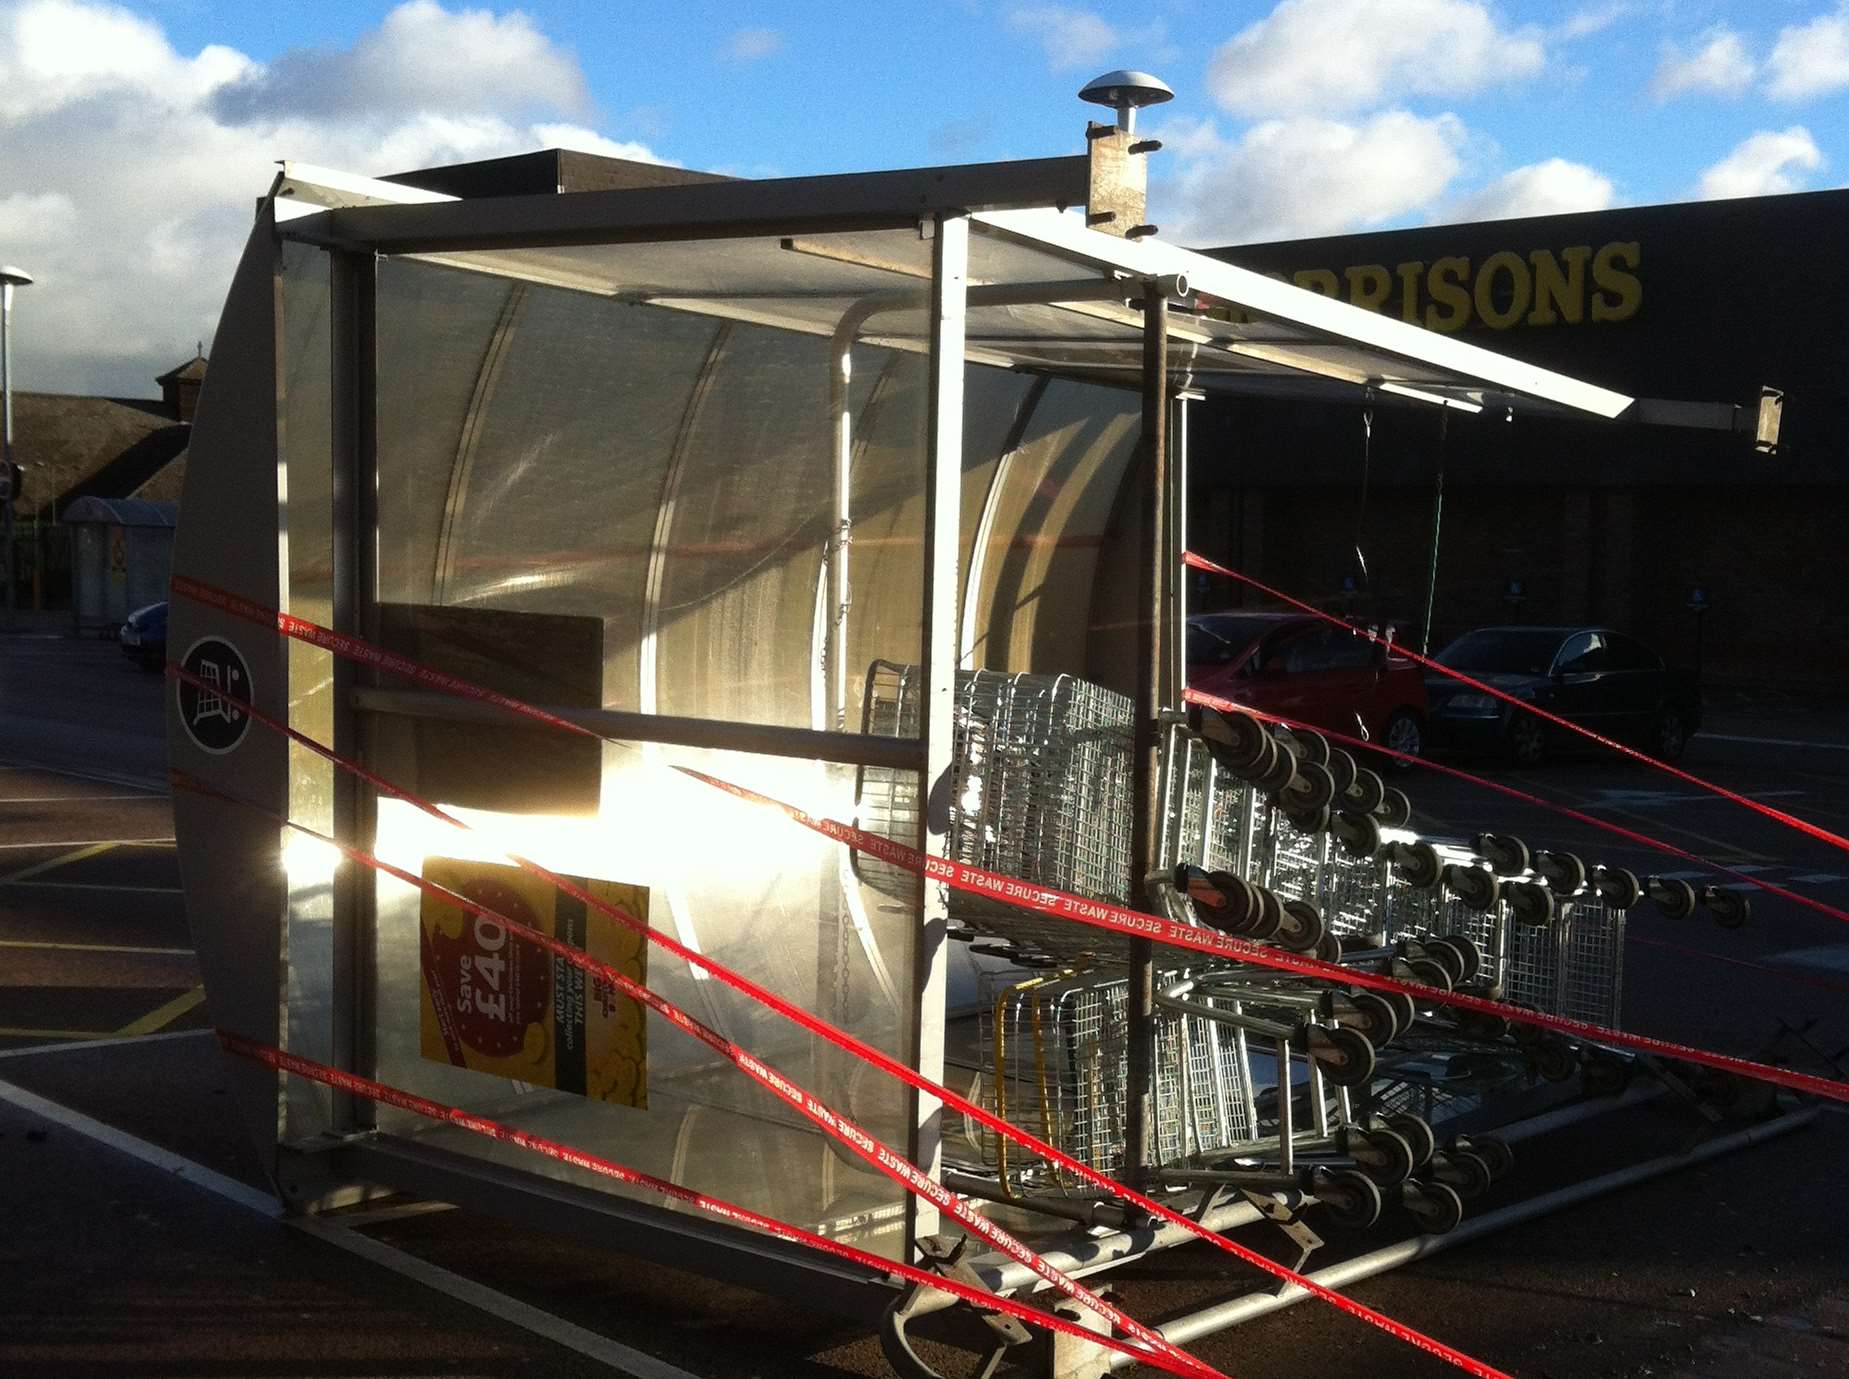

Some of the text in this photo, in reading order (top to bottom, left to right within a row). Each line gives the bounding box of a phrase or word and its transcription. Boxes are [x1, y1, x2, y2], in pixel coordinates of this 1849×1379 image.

[457, 955, 472, 1014] Save
[474, 914, 507, 1022] £40
[556, 986, 565, 1023] MUST
[574, 993, 583, 1024] THIS
[565, 994, 574, 1050] collecting
[766, 1072, 803, 1104] SECURE
[806, 1099, 838, 1127] WASTE
[837, 1119, 875, 1154] SECURE
[877, 1148, 911, 1179] WASTE
[910, 1175, 950, 1206] SECURE
[954, 1202, 990, 1234] WASTE
[990, 1230, 1032, 1264] SECURE
[1036, 1261, 1075, 1294] WASTE
[1075, 1290, 1121, 1325] SECURE
